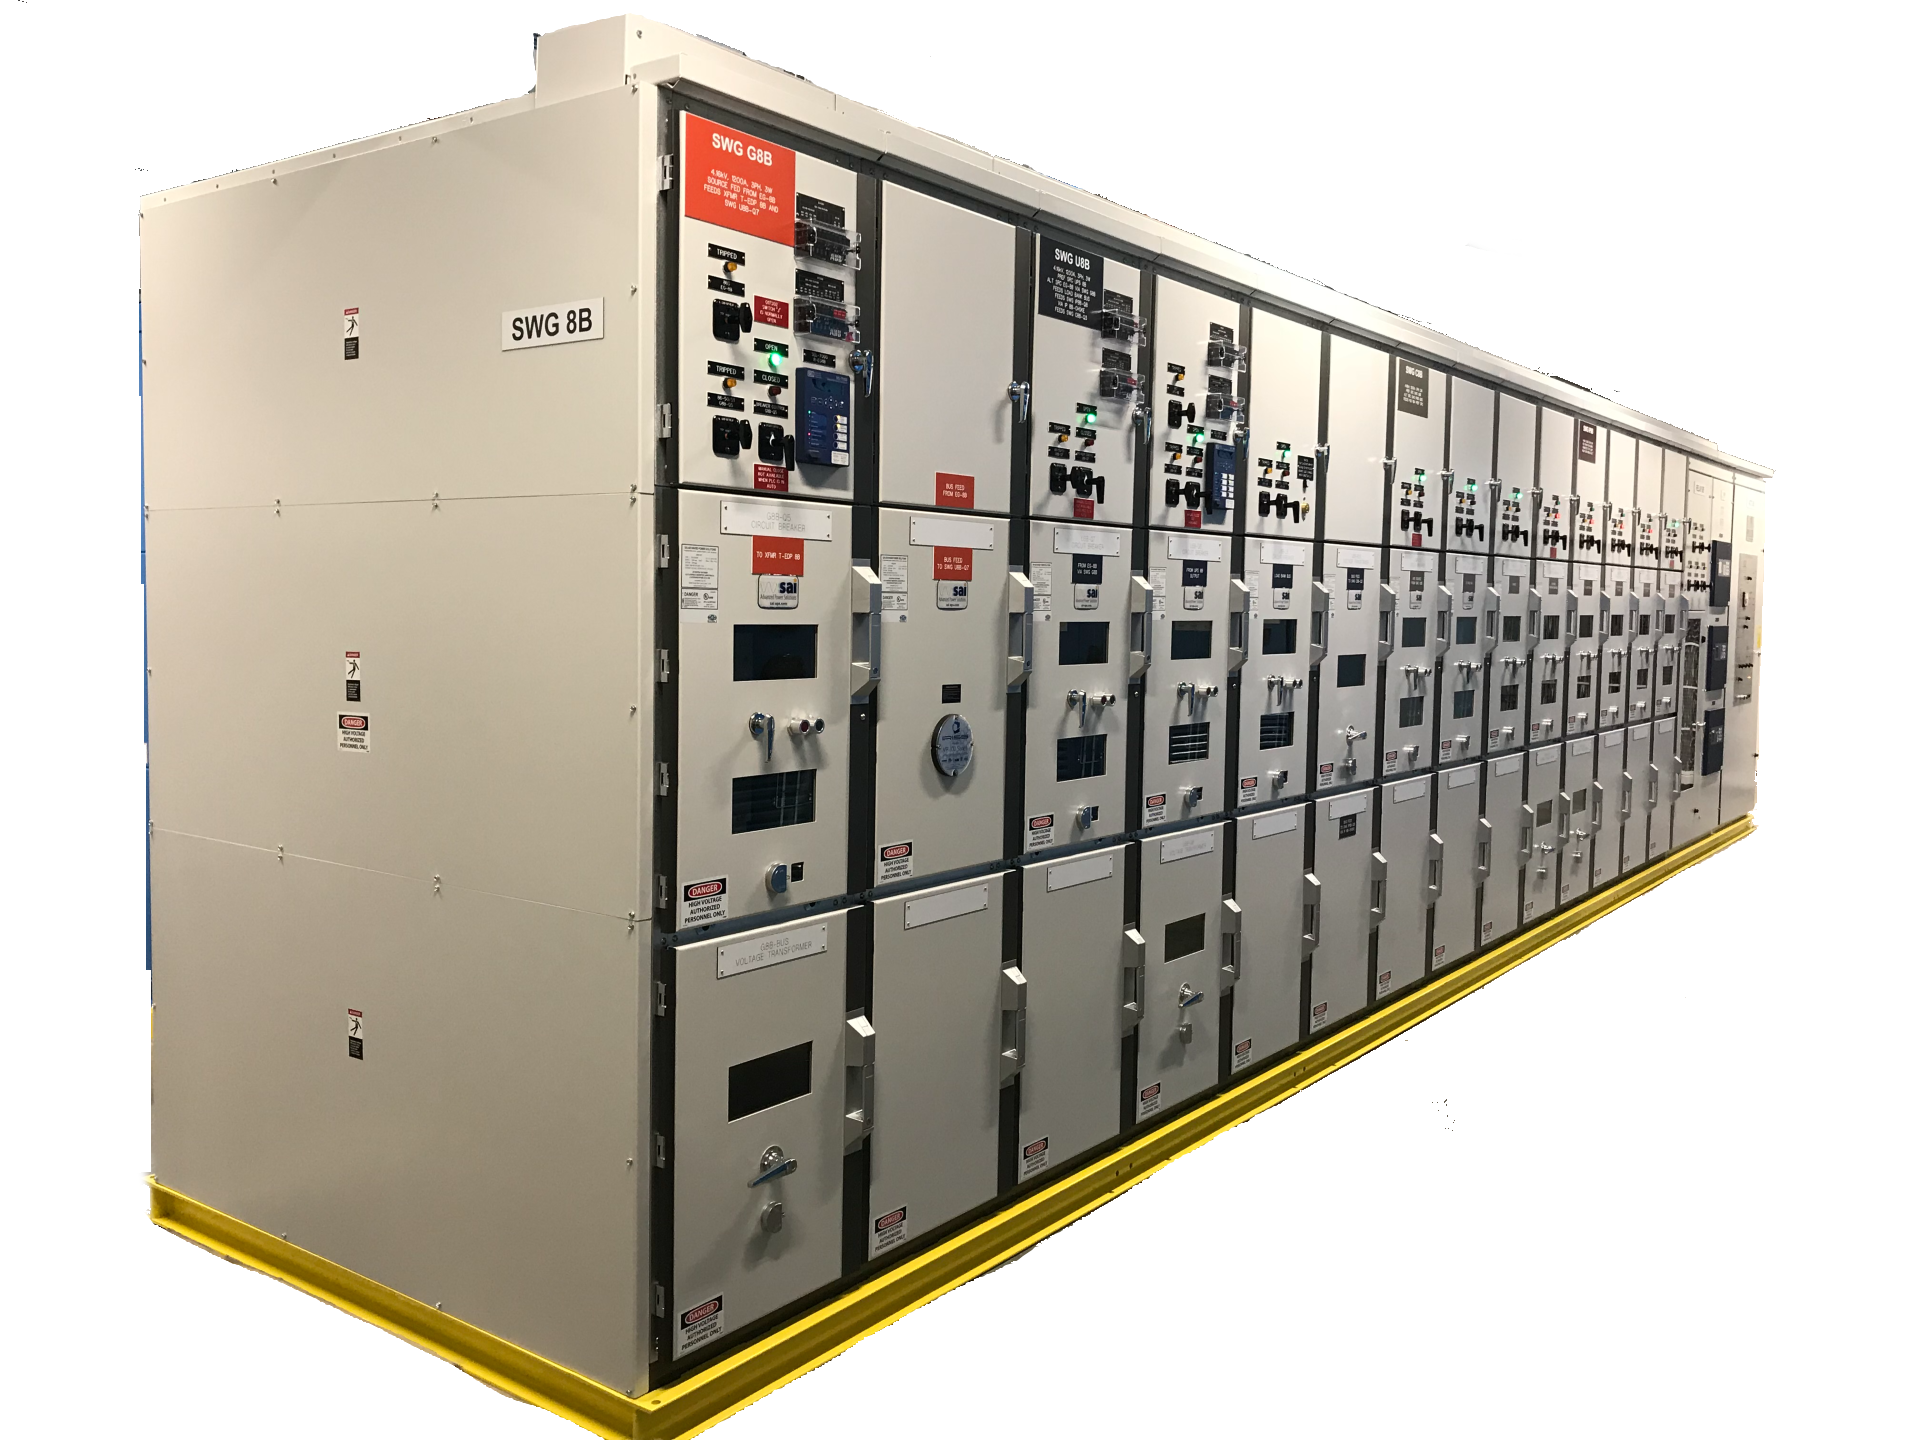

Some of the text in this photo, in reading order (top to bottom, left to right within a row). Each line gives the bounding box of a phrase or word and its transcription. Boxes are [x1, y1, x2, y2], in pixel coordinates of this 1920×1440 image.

[712, 133, 772, 166] SWG G8B
[708, 176, 728, 188] SOURCE
[731, 184, 740, 192] FED
[743, 188, 757, 197] FROM
[704, 184, 720, 195] FEEDS
[769, 205, 778, 213] AND
[724, 199, 736, 208] SWG
[717, 248, 738, 260] TRIPPED
[1054, 248, 1090, 270] SWG U8B
[512, 308, 592, 340] SWG 8B
[765, 344, 778, 352] OPEN
[716, 365, 736, 375] TRIPPED
[762, 374, 780, 383] CLOSED
[751, 521, 806, 532] CIRCUIT BREAKER
[779, 578, 797, 594] sai
[953, 583, 967, 596] sai
[887, 847, 906, 856] DANGER
[692, 884, 718, 896] DANGER
[701, 896, 722, 905] VOLTAGE
[690, 903, 720, 915] AUTHORIZED
[685, 913, 712, 924] PERSONNEL
[736, 941, 812, 966] VOLTAGE TRANSFORMER
[690, 1304, 714, 1320] DANGER
